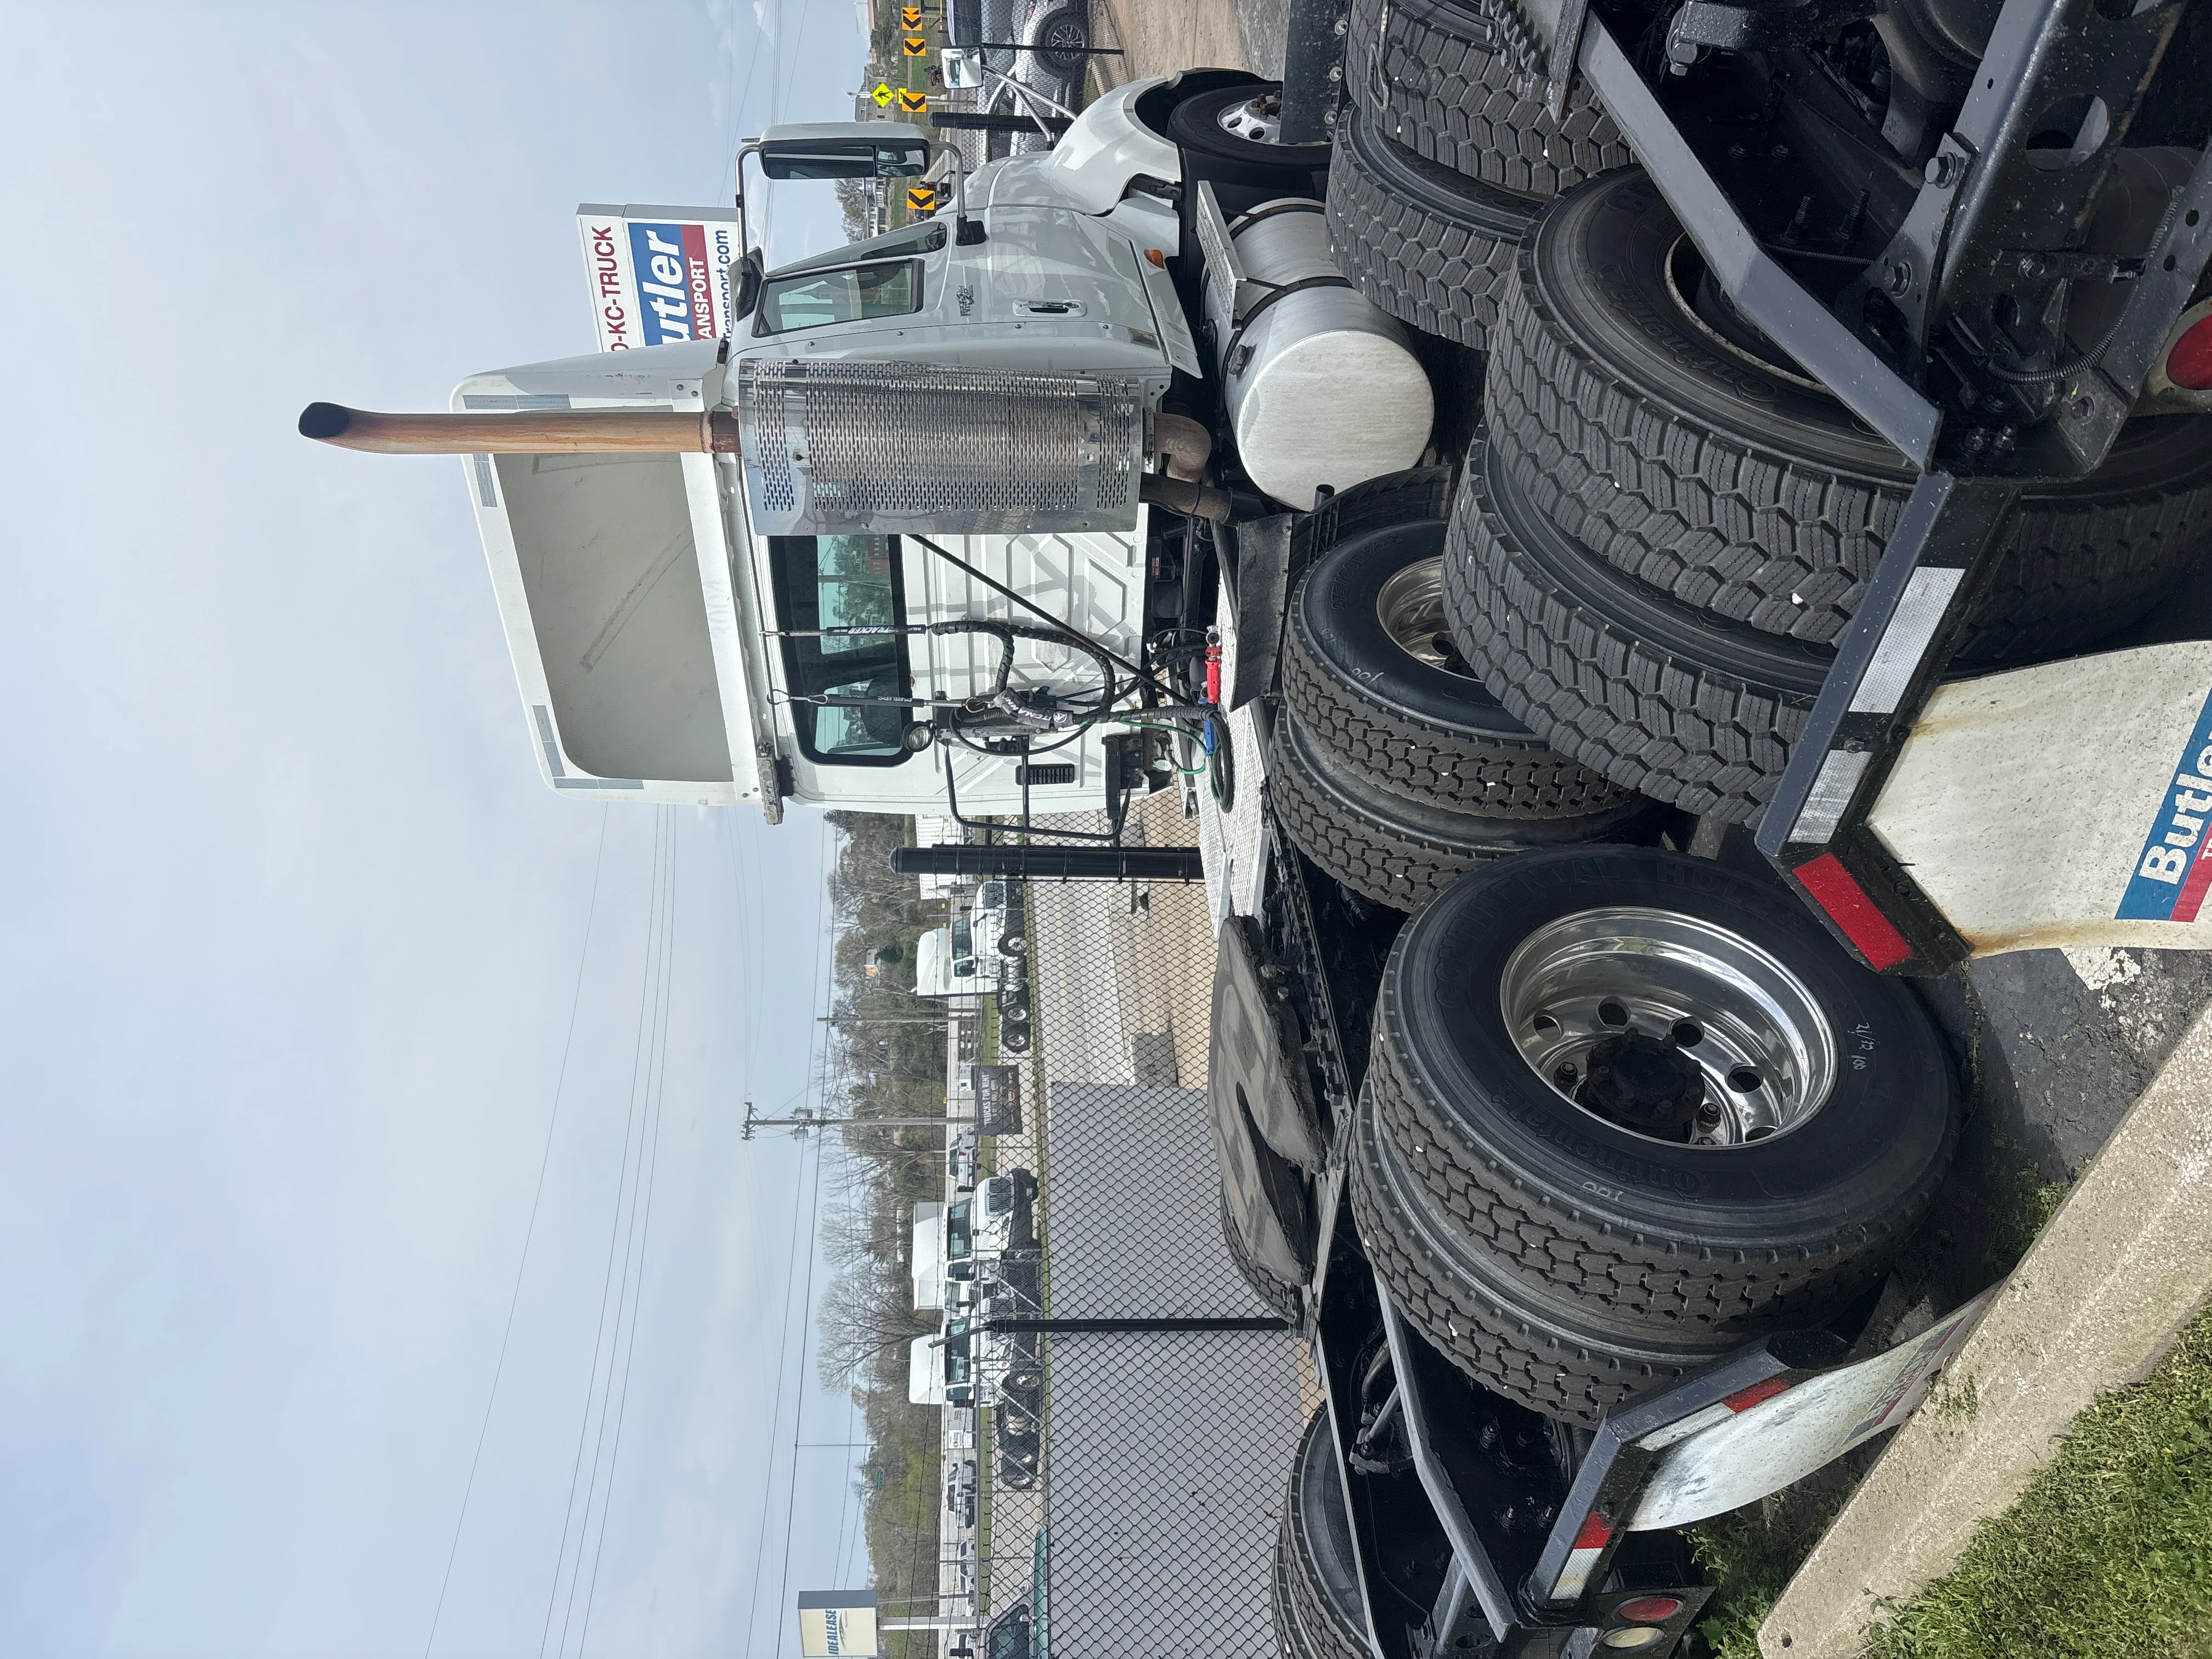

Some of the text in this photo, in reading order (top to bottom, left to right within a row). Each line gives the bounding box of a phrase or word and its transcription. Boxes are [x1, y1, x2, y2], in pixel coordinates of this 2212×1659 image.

[642, 230, 691, 345] utler
[689, 257, 713, 340] ANSPORT
[1850, 1055, 1867, 1070] 100
[981, 1074, 992, 1125] TRUCKS FOR RENT
[825, 1609, 839, 1655] IDEALEASE
